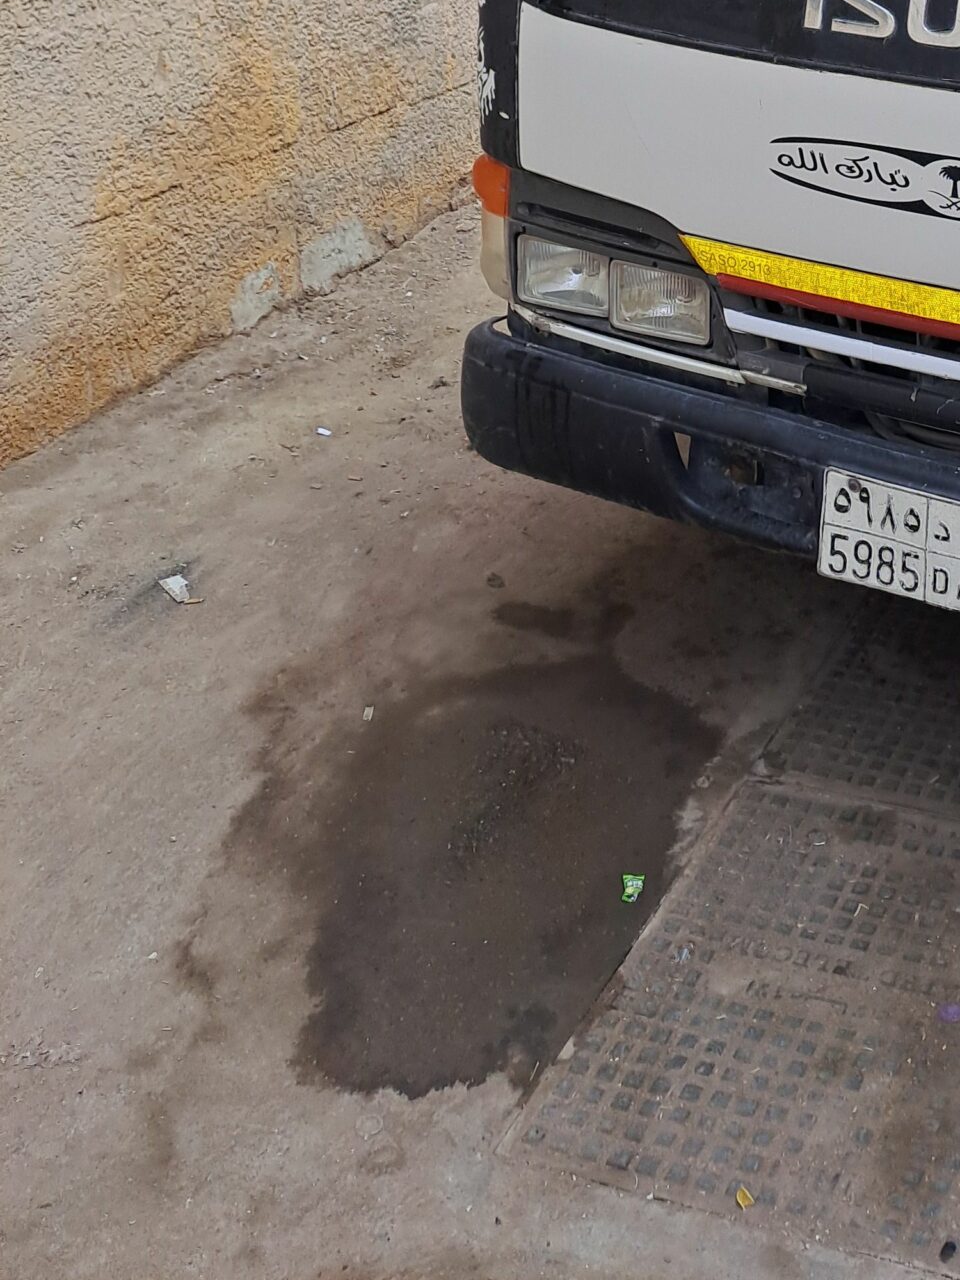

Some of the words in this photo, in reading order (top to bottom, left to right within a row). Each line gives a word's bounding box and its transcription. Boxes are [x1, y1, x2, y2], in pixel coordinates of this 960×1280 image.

[777, 146, 829, 175] الله
[834, 155, 910, 192] تبارك
[699, 249, 738, 269] SASO
[827, 532, 920, 593] 5985
